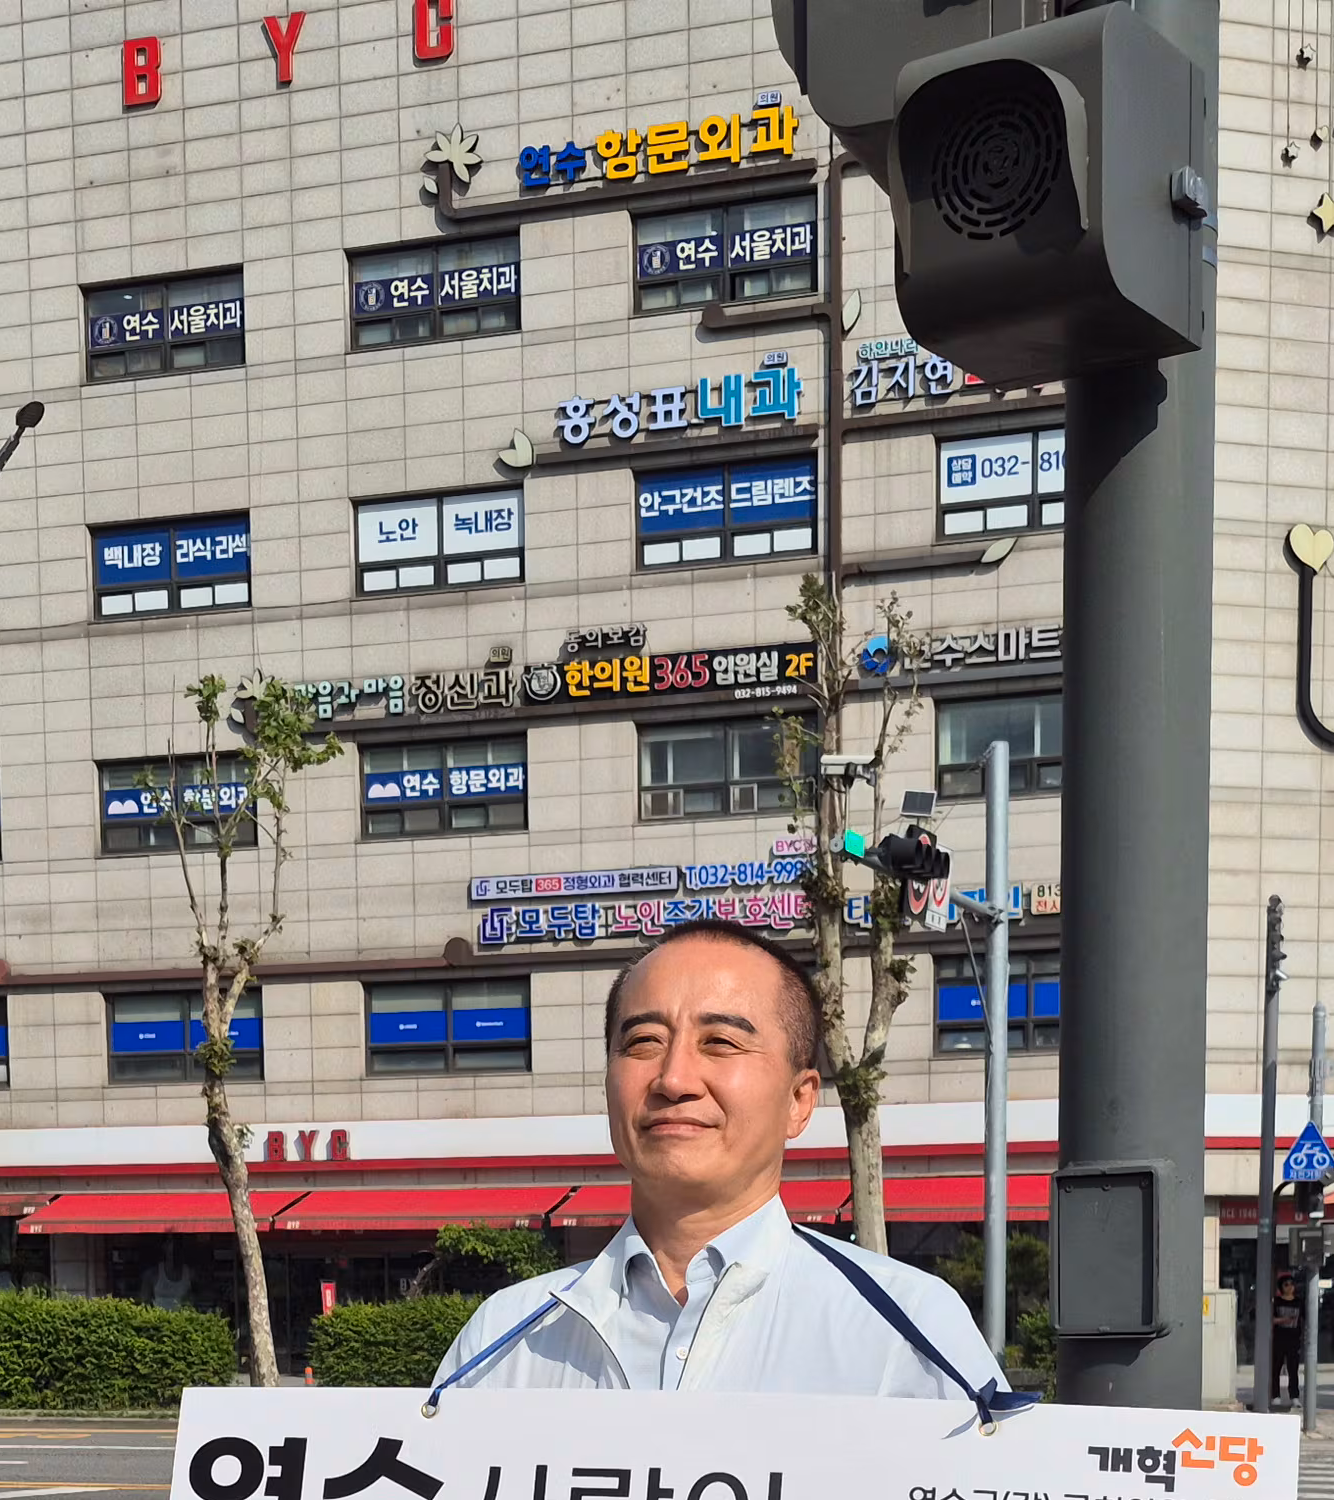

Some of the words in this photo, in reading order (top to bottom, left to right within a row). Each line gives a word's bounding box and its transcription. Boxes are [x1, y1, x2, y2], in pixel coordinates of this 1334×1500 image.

[759, 92, 781, 104] 의원
[518, 141, 586, 188] 연수
[594, 105, 799, 181] 항문외과
[676, 236, 720, 270] 연수
[730, 224, 814, 264] 서울치과
[390, 274, 430, 309] 연수
[440, 264, 517, 301] 서울치과
[122, 309, 161, 342] 연수
[169, 301, 242, 335] 서울치과
[766, 352, 786, 364] 의원
[557, 385, 688, 444] 홍성표
[698, 366, 803, 427] 내과
[950, 457, 974, 471] 상담
[951, 471, 974, 484] 예약
[639, 484, 724, 518] 안구건조
[729, 475, 816, 508] 드림렌즈
[378, 517, 418, 543] 노안
[454, 508, 514, 536] 녹내장
[103, 541, 162, 570] 백내장
[492, 648, 510, 661] 의원
[567, 624, 648, 652] 동의보감
[565, 656, 650, 698] 한의원
[654, 654, 709, 690] 365
[713, 651, 779, 686] 입원실
[785, 653, 814, 677] 2F
[363, 675, 404, 714] 마음
[413, 670, 516, 713] 정신과
[734, 684, 799, 700] 032-815-9494
[403, 773, 440, 798] 연수
[449, 767, 525, 794] 항문외과
[496, 879, 533, 894] 모두탑
[537, 878, 560, 892] 365
[563, 875, 615, 891] 정형외과
[618, 871, 672, 887] 협력센터
[519, 904, 600, 938] 모두탑
[267, 1129, 350, 1161] BYC
[1087, 1428, 1264, 1493] 개혁신당
